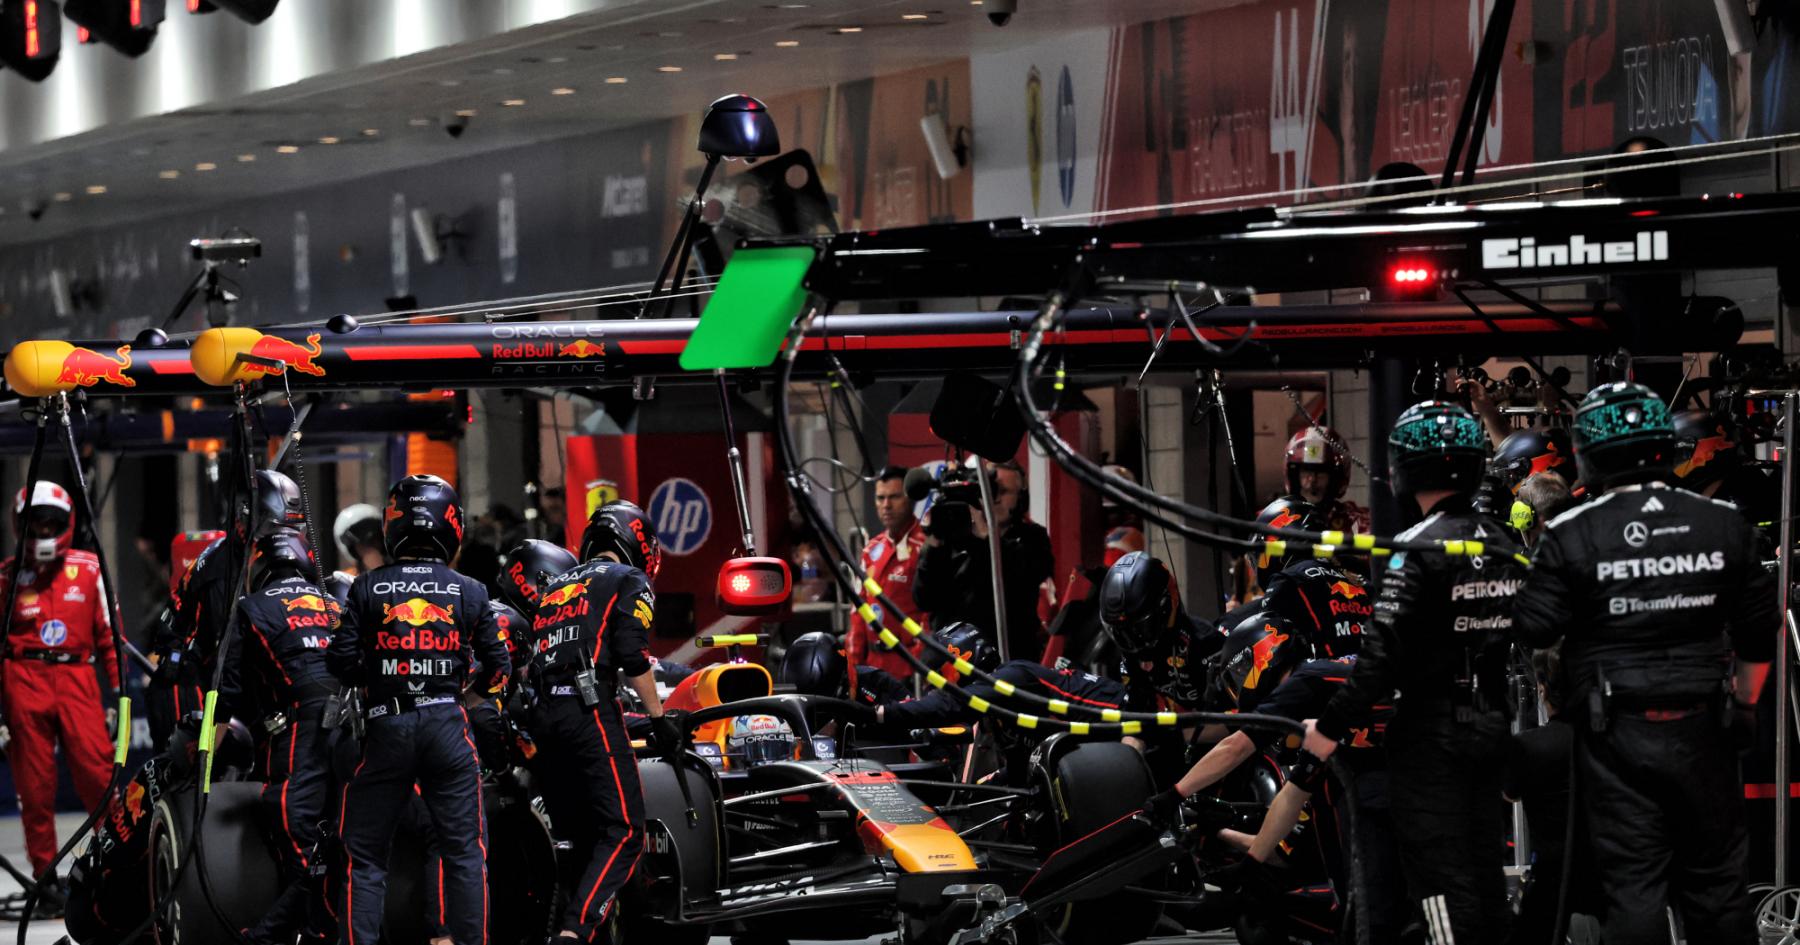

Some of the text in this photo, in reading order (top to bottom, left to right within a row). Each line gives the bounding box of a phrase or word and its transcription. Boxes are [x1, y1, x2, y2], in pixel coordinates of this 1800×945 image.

[1623, 34, 1718, 131] TSUNODA
[1481, 230, 1668, 269] Einhell
[492, 325, 605, 338] ORACLE
[492, 342, 554, 359] Red Bull
[491, 364, 605, 376] RACING
[657, 480, 703, 553] hp
[1597, 551, 1726, 582] PETRONAS
[373, 581, 461, 595] ORACLE
[1627, 594, 1717, 612] TeamViewer
[375, 628, 462, 651] Red Bull
[382, 658, 433, 675] Mobil
[745, 734, 785, 744] ORACLE
